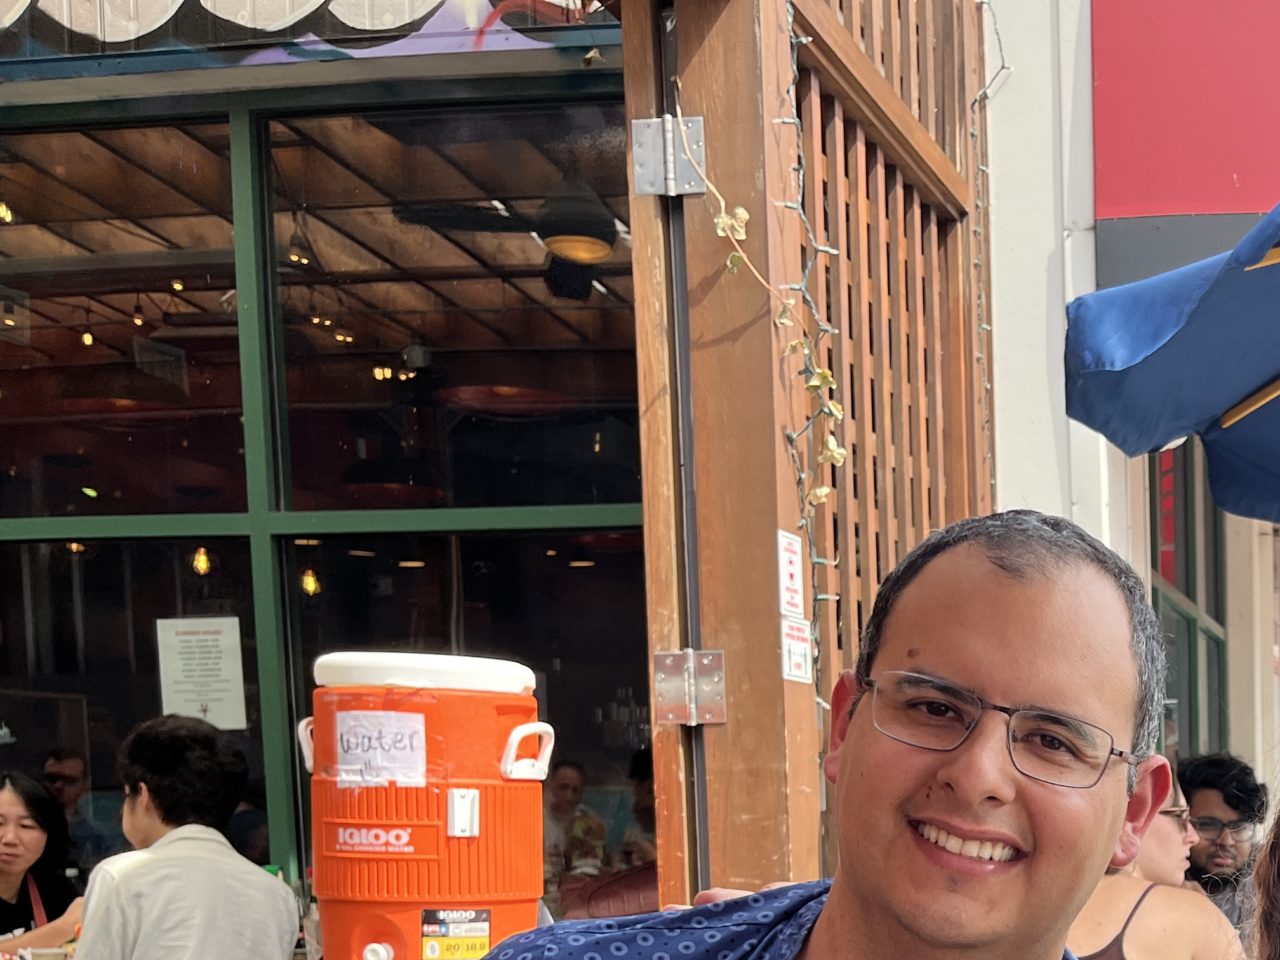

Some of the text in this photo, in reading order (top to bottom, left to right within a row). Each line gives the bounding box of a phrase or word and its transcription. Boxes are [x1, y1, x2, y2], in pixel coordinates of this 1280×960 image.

[339, 730, 420, 755] water
[338, 827, 411, 846] IGLOO
[439, 910, 476, 920] IGLOO
